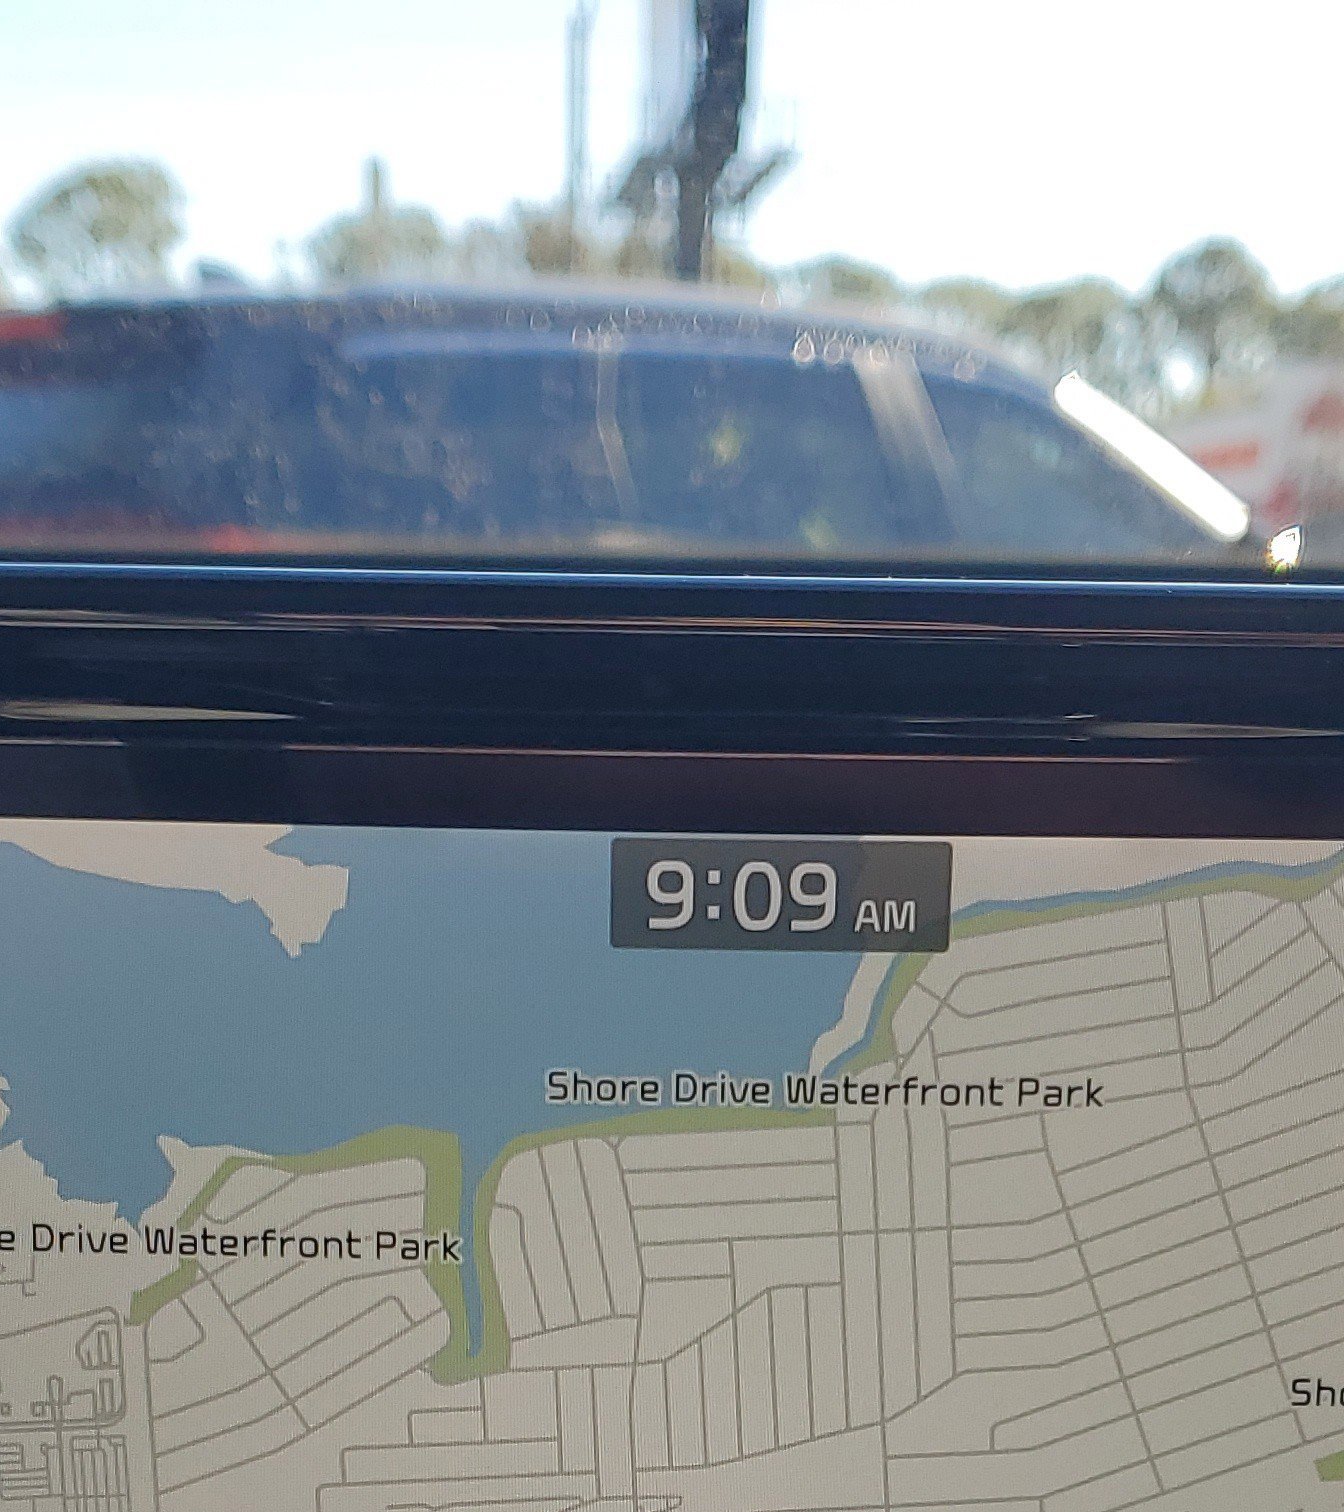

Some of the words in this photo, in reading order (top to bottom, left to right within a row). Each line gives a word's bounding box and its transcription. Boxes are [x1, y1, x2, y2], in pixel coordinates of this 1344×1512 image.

[645, 859, 838, 933] 9:09
[853, 901, 917, 933] AM
[548, 1071, 659, 1104] Shore
[675, 1073, 770, 1105] Drive
[785, 1075, 1003, 1107] Waterfront
[1018, 1077, 1103, 1108] Park
[32, 1222, 128, 1255] Drive
[143, 1225, 361, 1260] Waterfront
[376, 1231, 461, 1263] Park
